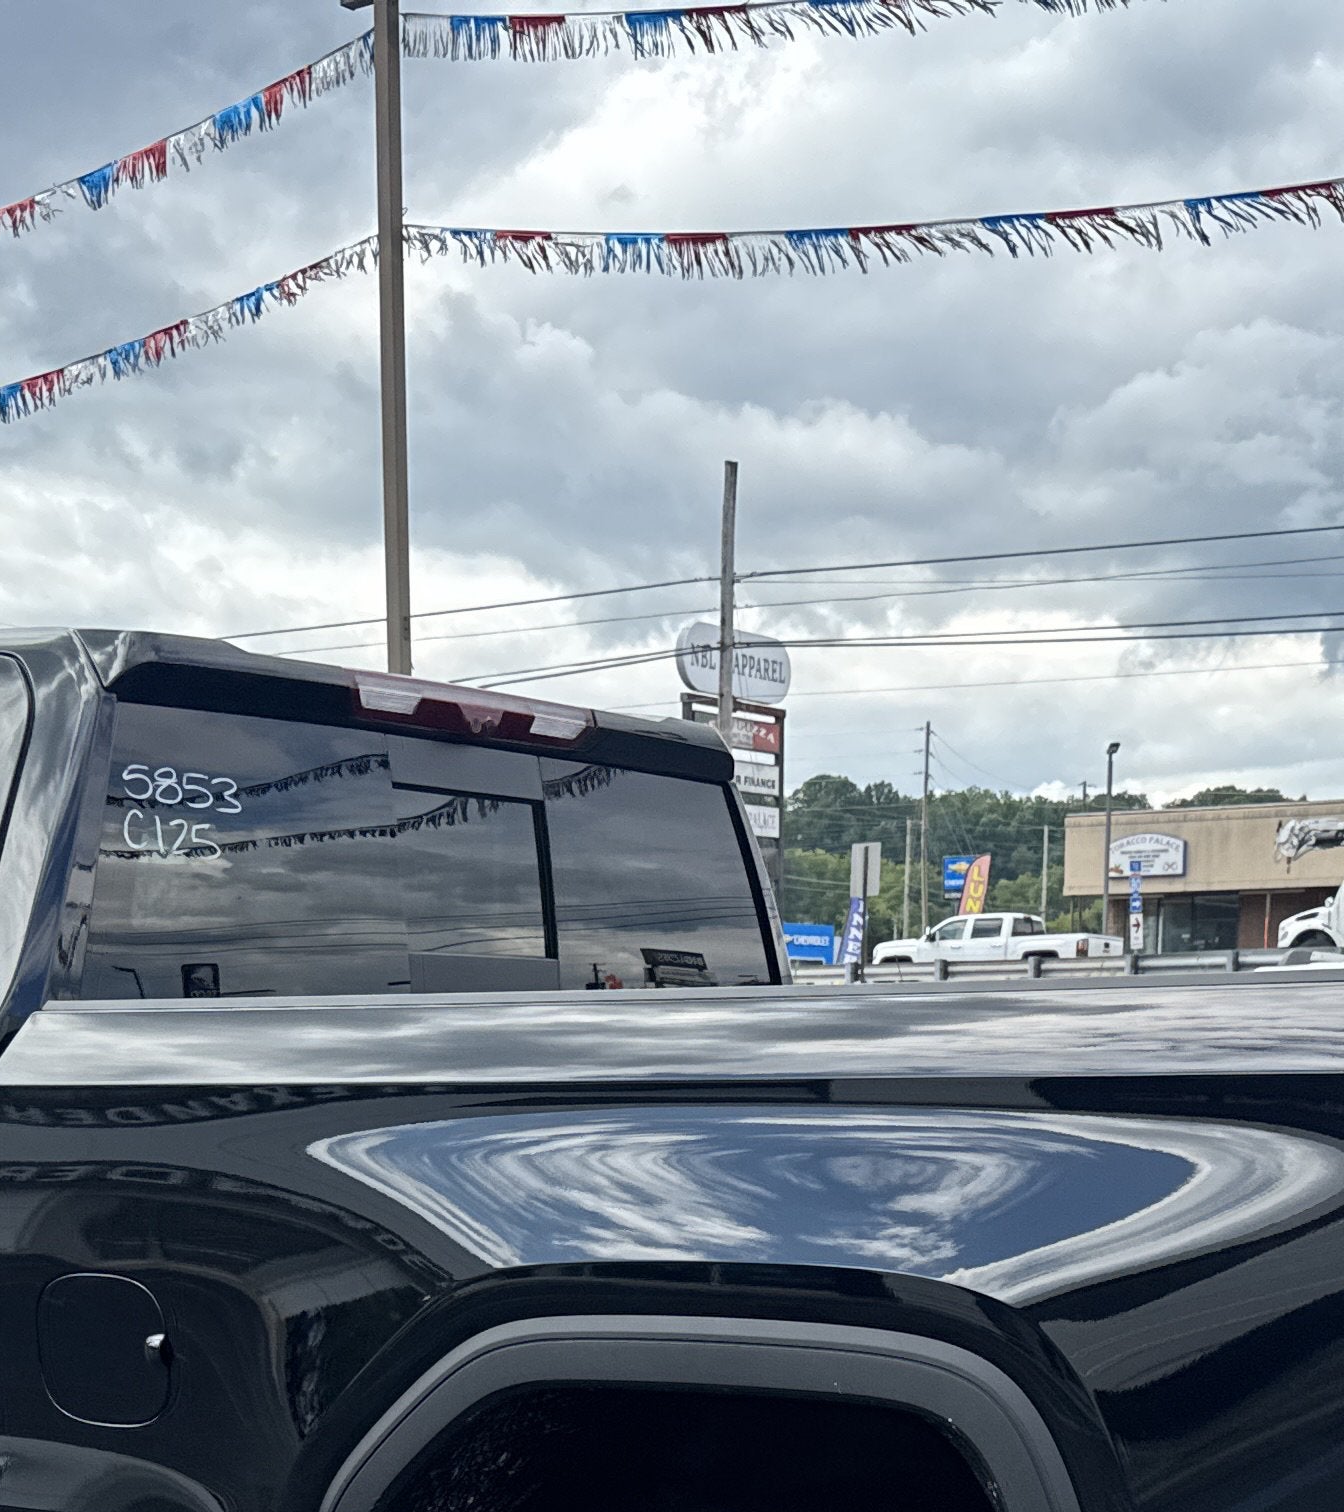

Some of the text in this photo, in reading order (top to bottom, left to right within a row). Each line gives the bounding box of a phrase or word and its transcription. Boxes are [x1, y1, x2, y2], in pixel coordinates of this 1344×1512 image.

[732, 651, 786, 684] APPAREL
[736, 720, 775, 744] PIZZA
[122, 764, 242, 814] 5853
[743, 775, 776, 790] FINANCE
[123, 809, 221, 860] C125
[966, 865, 985, 913] LUN
